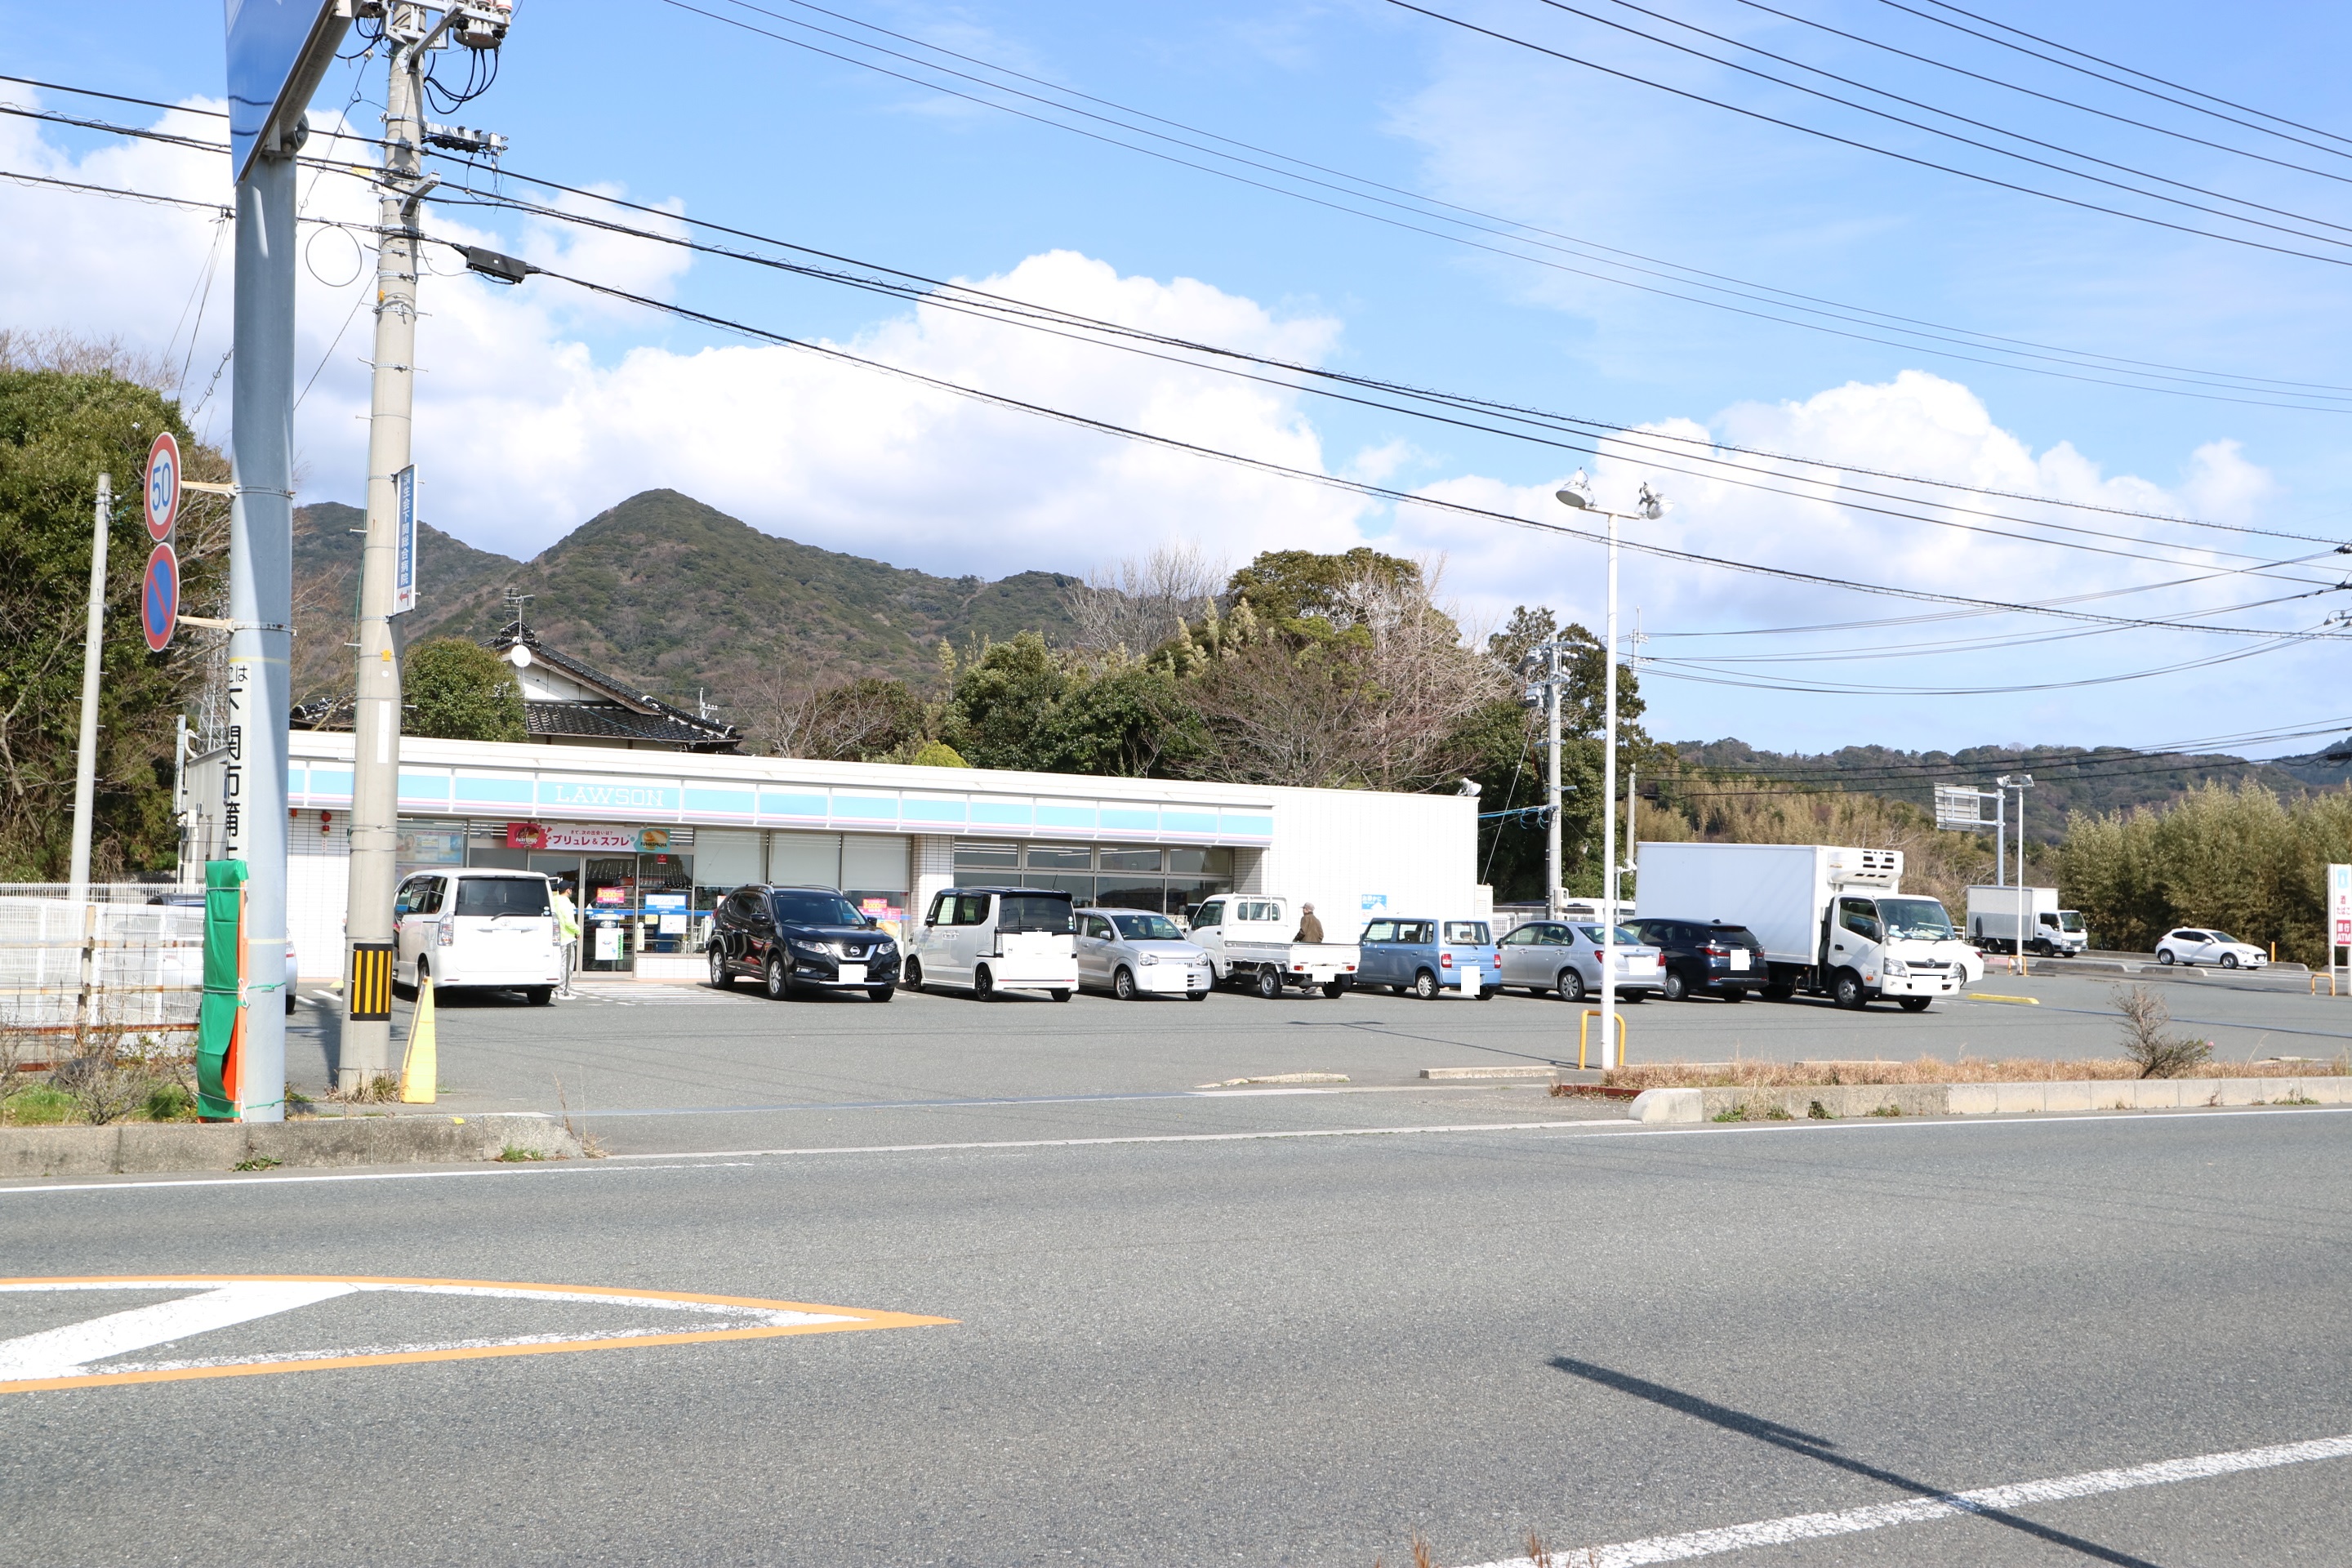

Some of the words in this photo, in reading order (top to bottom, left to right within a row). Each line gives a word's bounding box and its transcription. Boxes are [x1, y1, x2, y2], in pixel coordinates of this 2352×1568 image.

[152, 461, 171, 512] 50
[400, 472, 412, 586] 済生会下関総合病院
[555, 785, 664, 807] LAWSON
[2341, 895, 2346, 904] 酒
[2336, 906, 2350, 915] たばこ
[2337, 933, 2350, 942] ATM
